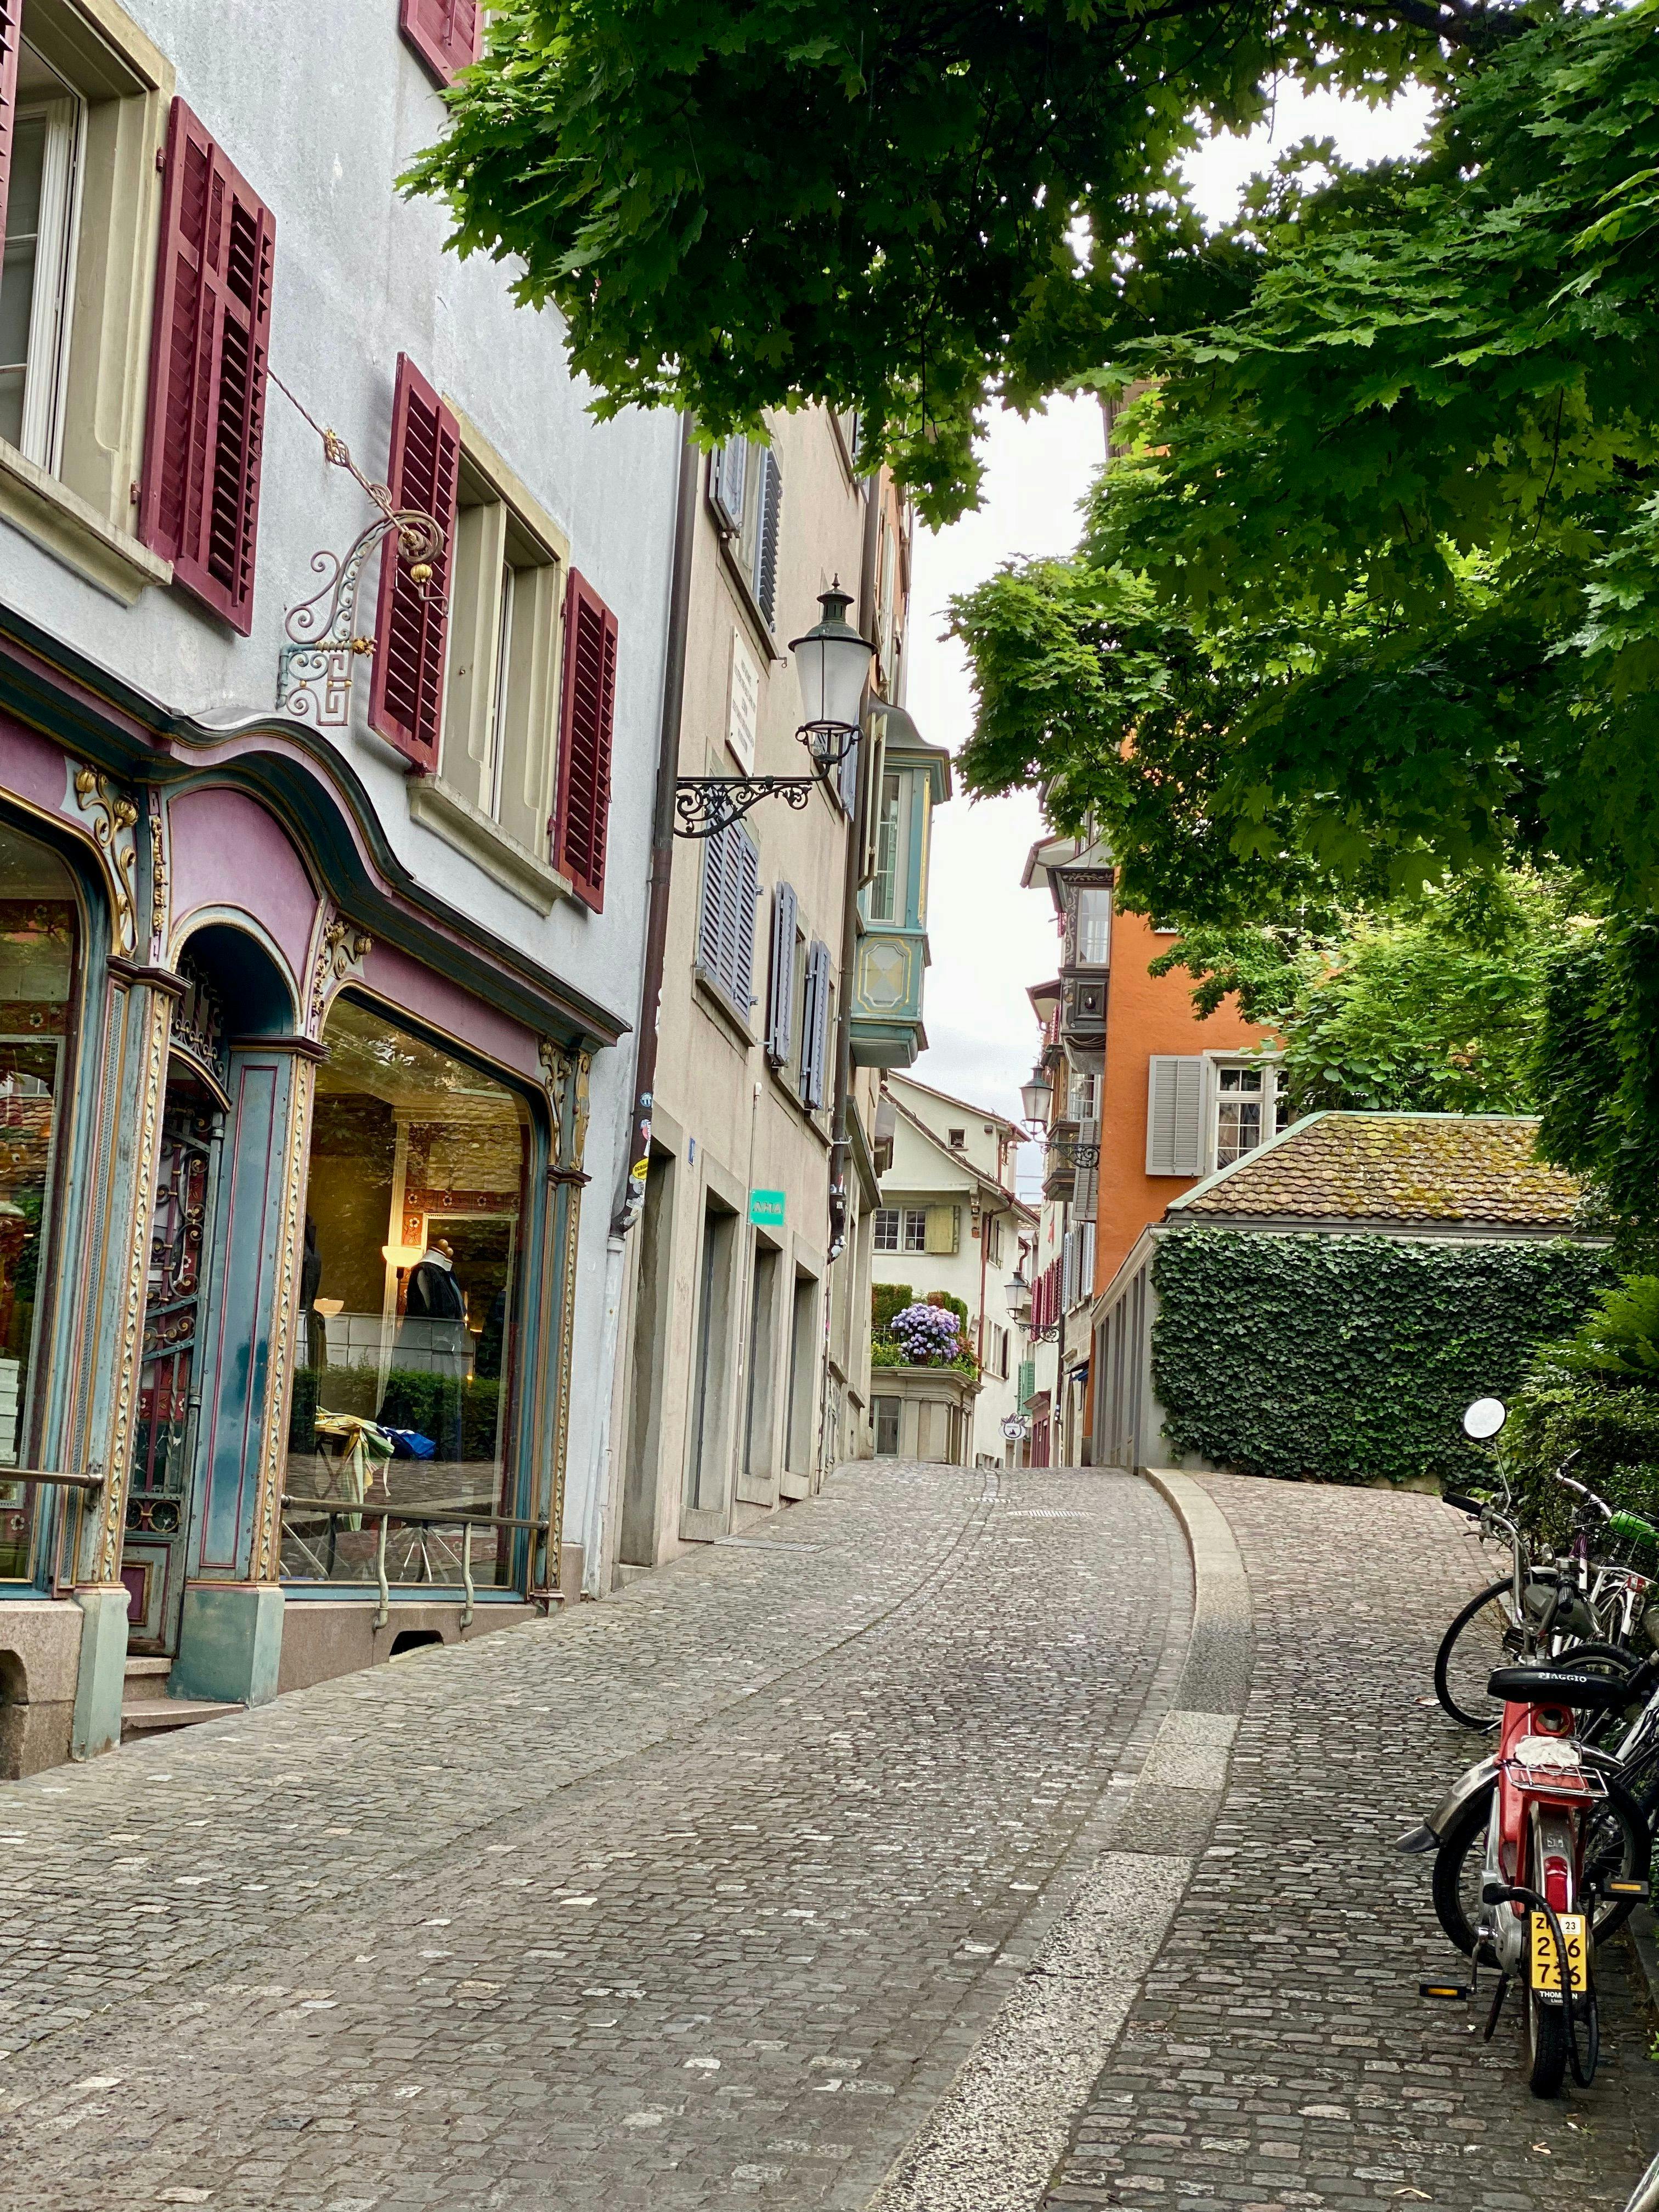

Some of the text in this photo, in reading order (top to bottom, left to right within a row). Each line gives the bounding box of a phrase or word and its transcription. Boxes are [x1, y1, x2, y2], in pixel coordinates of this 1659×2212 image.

[752, 1201, 783, 1214] AHA
[1538, 1672, 1587, 1683] PIAGGIO
[1565, 1922, 1576, 1930] 23
[1537, 1937, 1581, 1958] 26
[1539, 1991, 1578, 2000] THOMN
